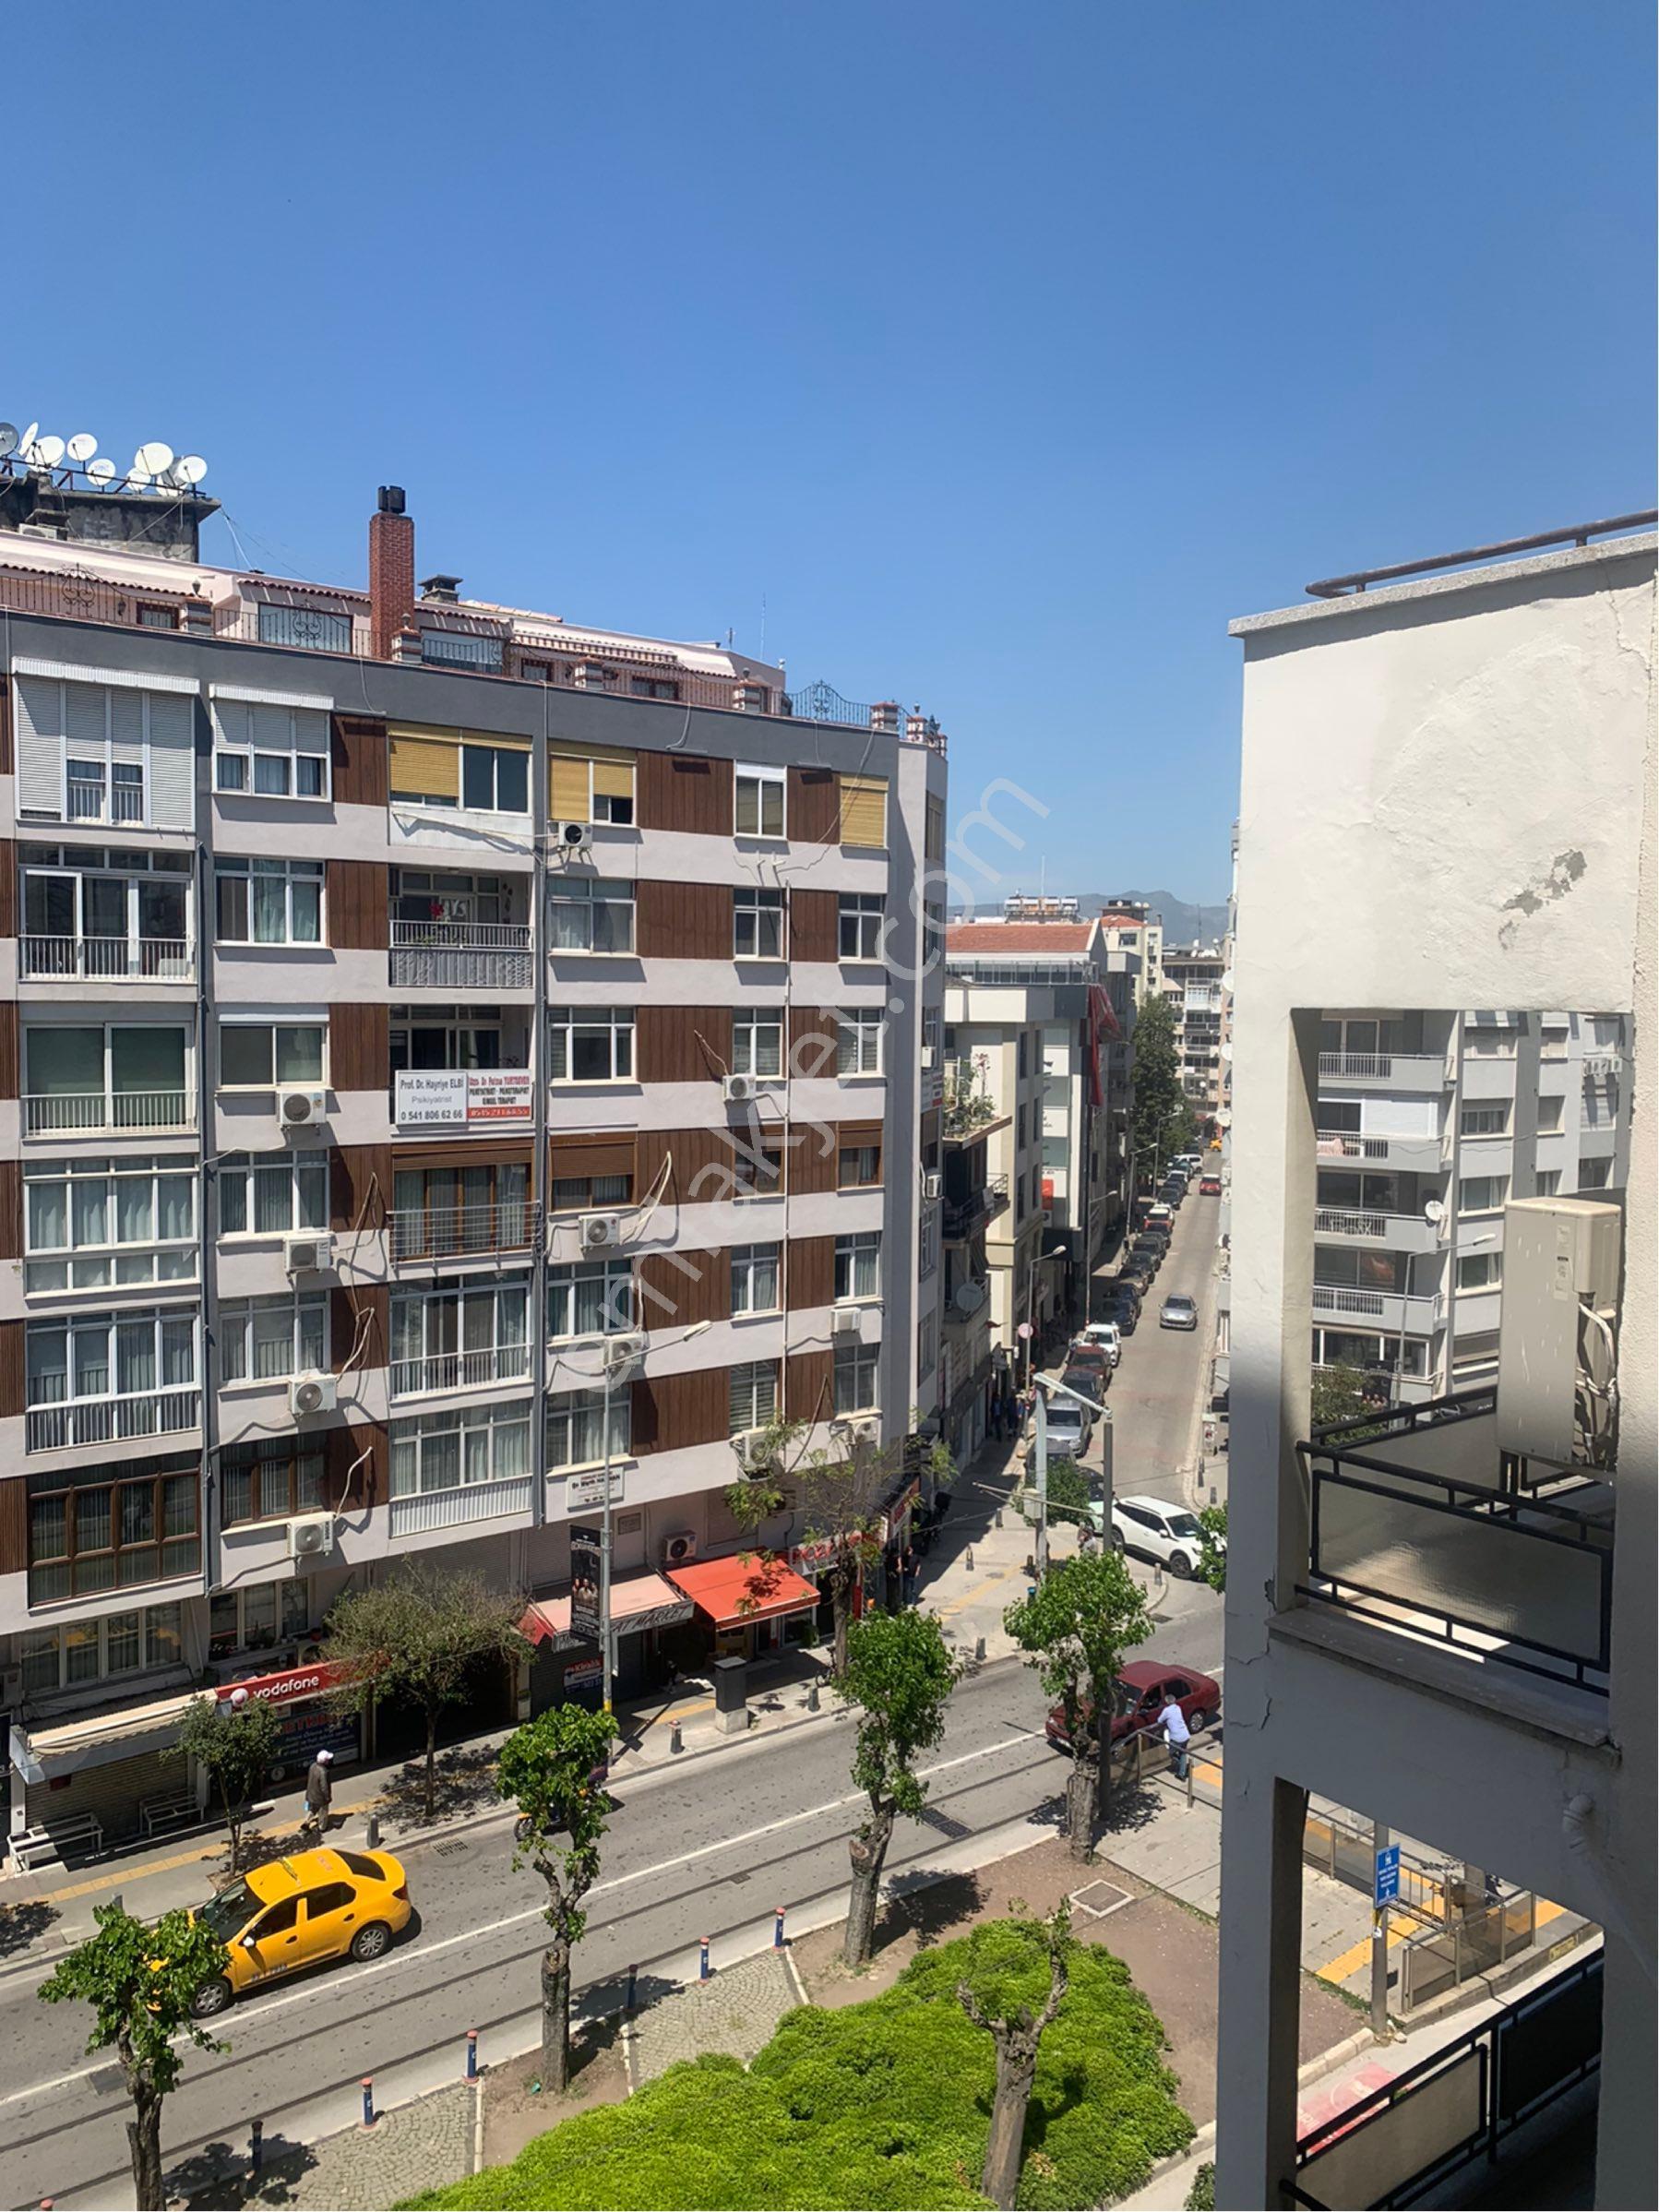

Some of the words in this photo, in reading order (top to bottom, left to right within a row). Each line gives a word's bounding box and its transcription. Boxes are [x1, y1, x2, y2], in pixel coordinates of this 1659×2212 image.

[400, 1111, 407, 1120] 0
[408, 1110, 423, 1120] 541
[253, 1675, 320, 1700] vodafone
